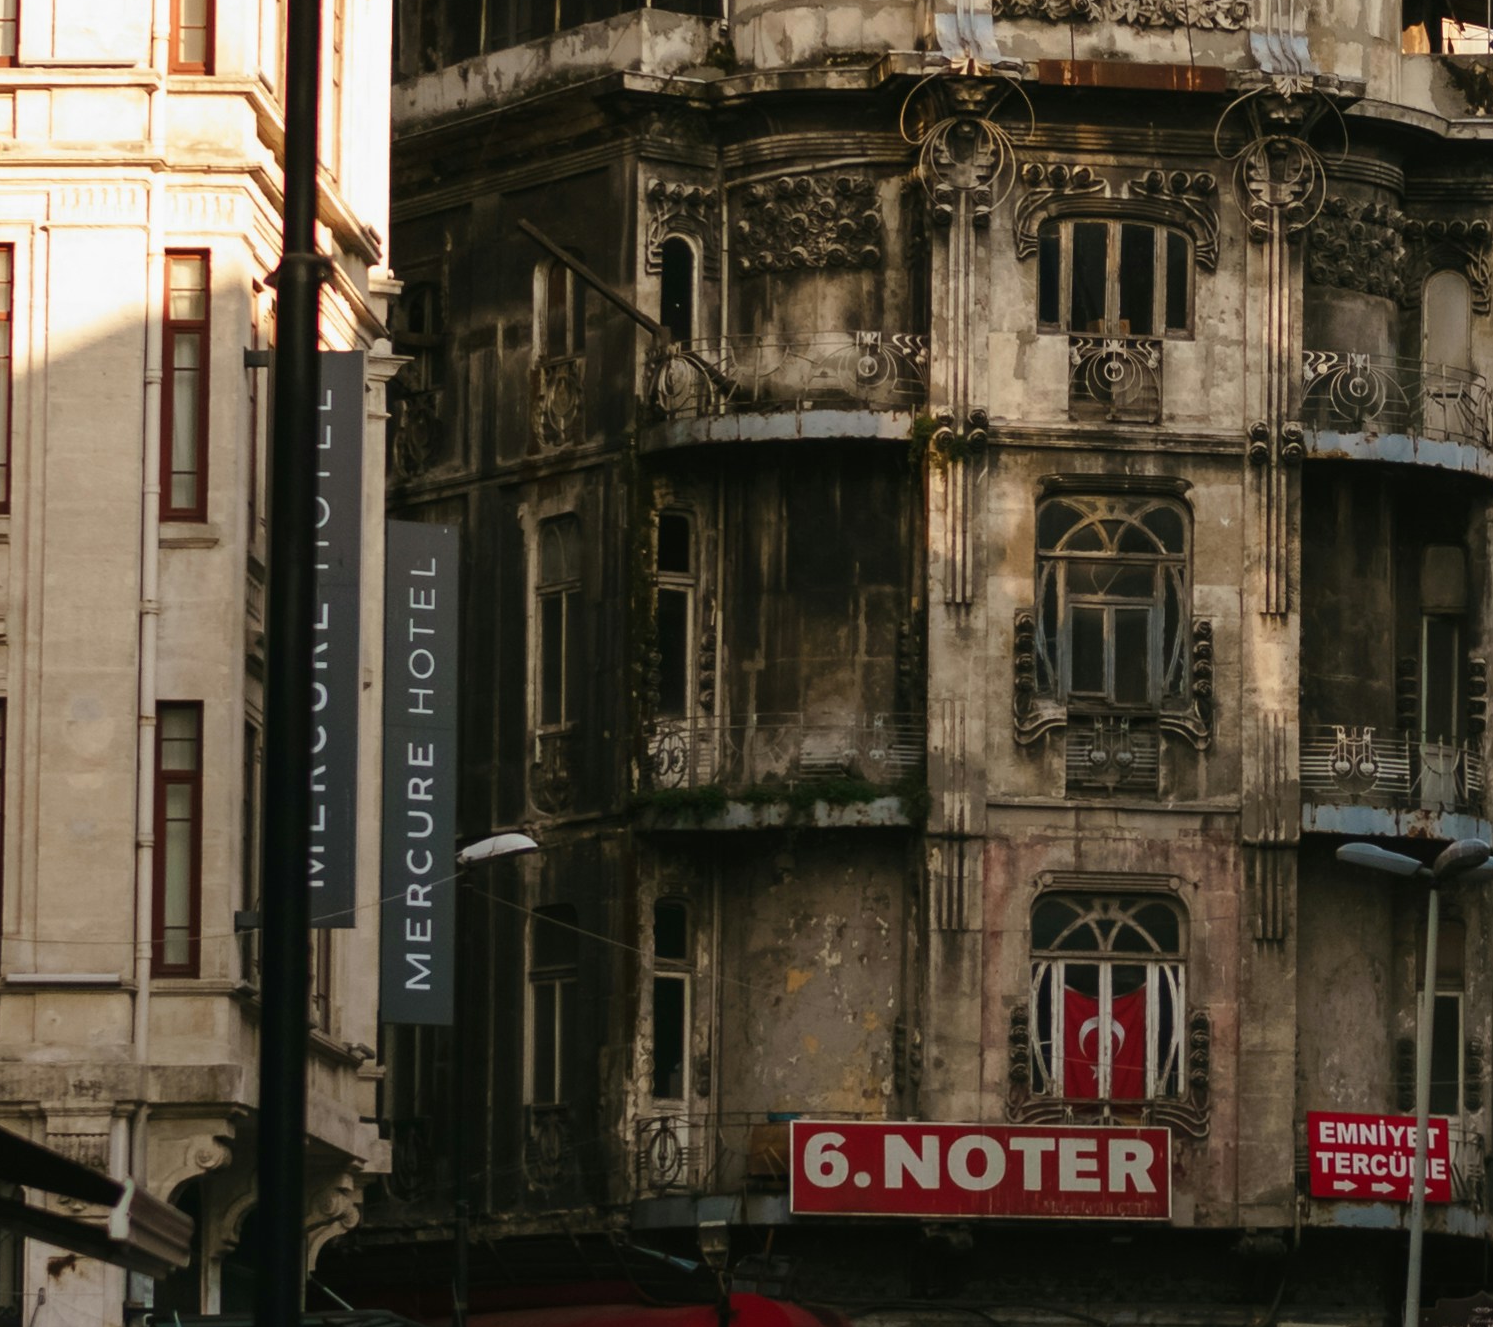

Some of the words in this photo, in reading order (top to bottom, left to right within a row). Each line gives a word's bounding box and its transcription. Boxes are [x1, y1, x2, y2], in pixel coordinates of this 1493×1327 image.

[407, 557, 436, 715] HOTEL
[404, 741, 434, 991] MERCURE
[1319, 1119, 1440, 1150] EMNİYET
